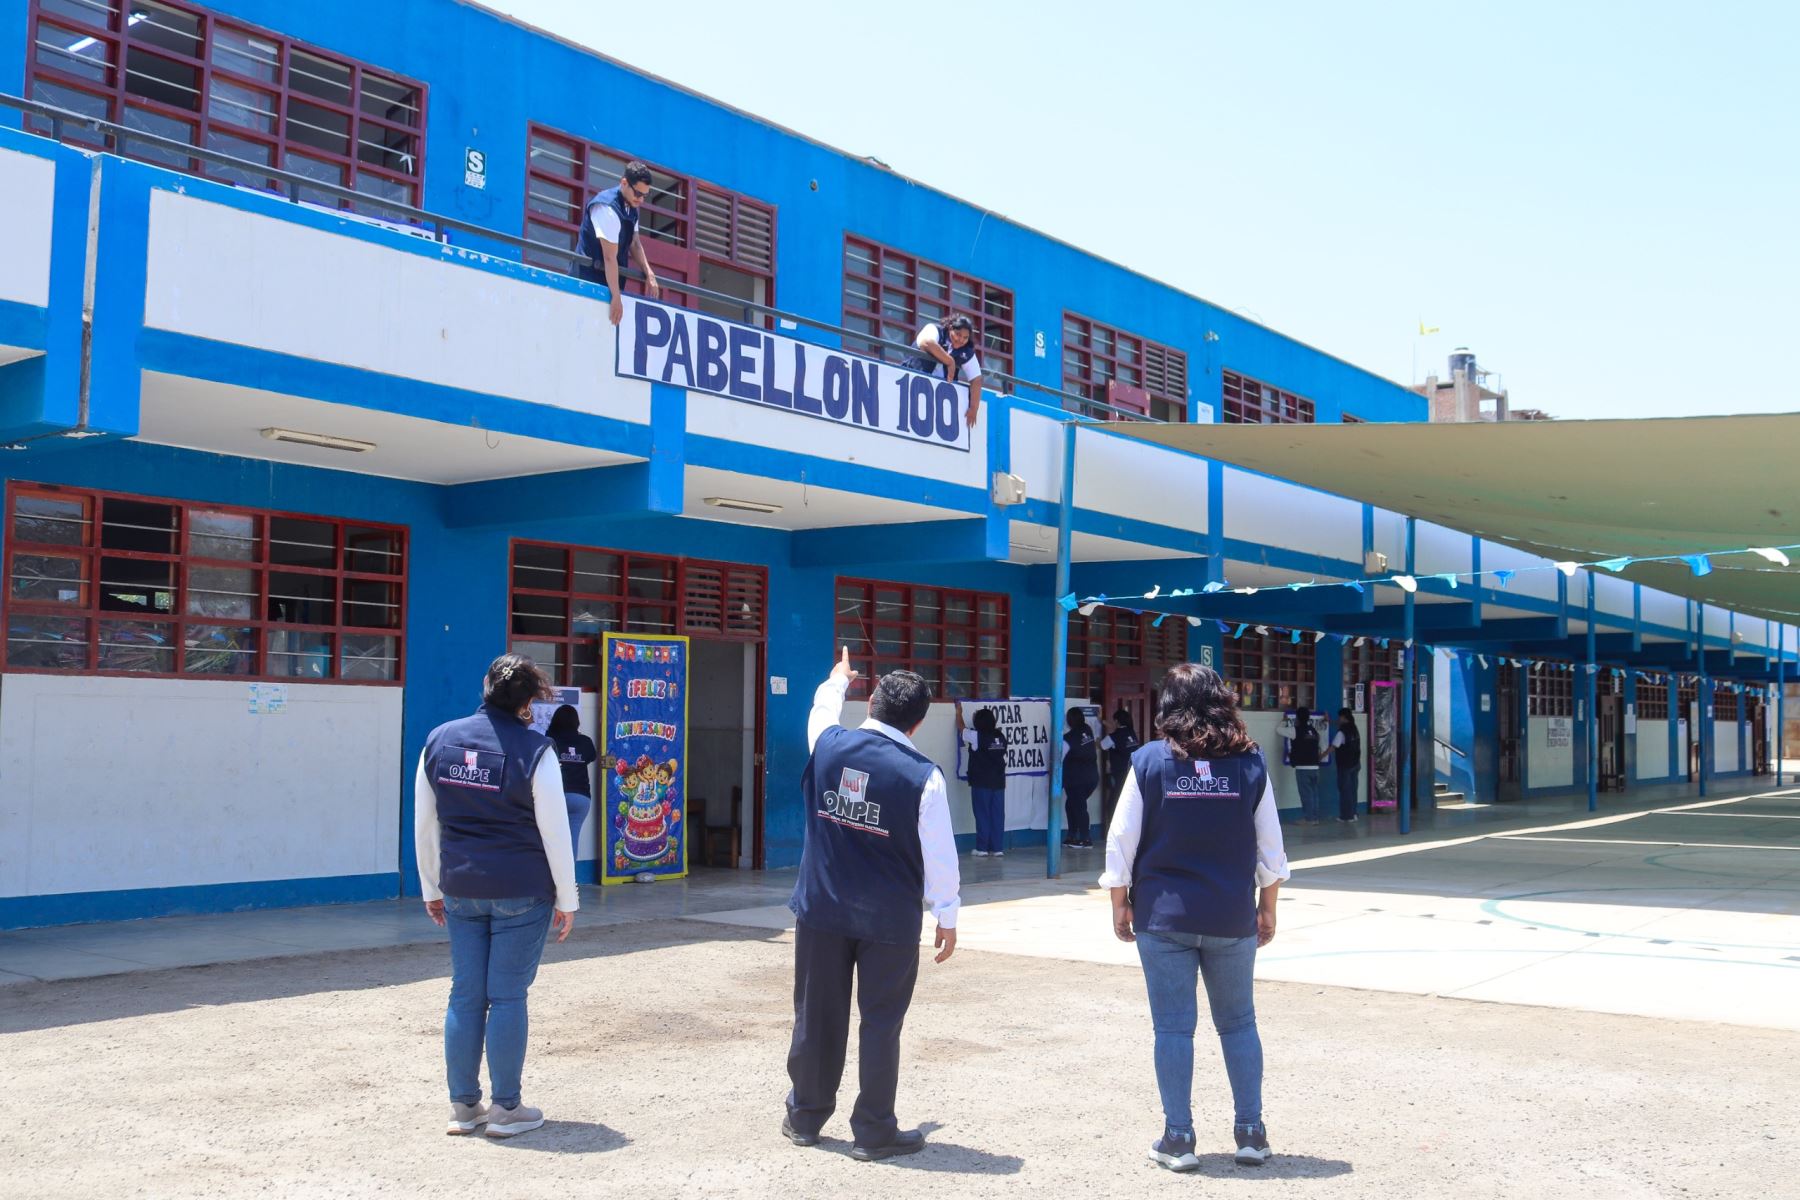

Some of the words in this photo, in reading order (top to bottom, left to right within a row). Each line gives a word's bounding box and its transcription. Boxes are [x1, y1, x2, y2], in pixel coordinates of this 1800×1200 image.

[468, 150, 484, 173] S
[1036, 332, 1044, 348] S
[895, 372, 960, 442] 100
[1203, 649, 1211, 666] S
[983, 704, 1022, 724] OTAR
[1033, 724, 1048, 744] LA
[449, 764, 490, 783] ONPE
[1176, 776, 1229, 791] ONPE
[823, 790, 880, 825] ONPE
